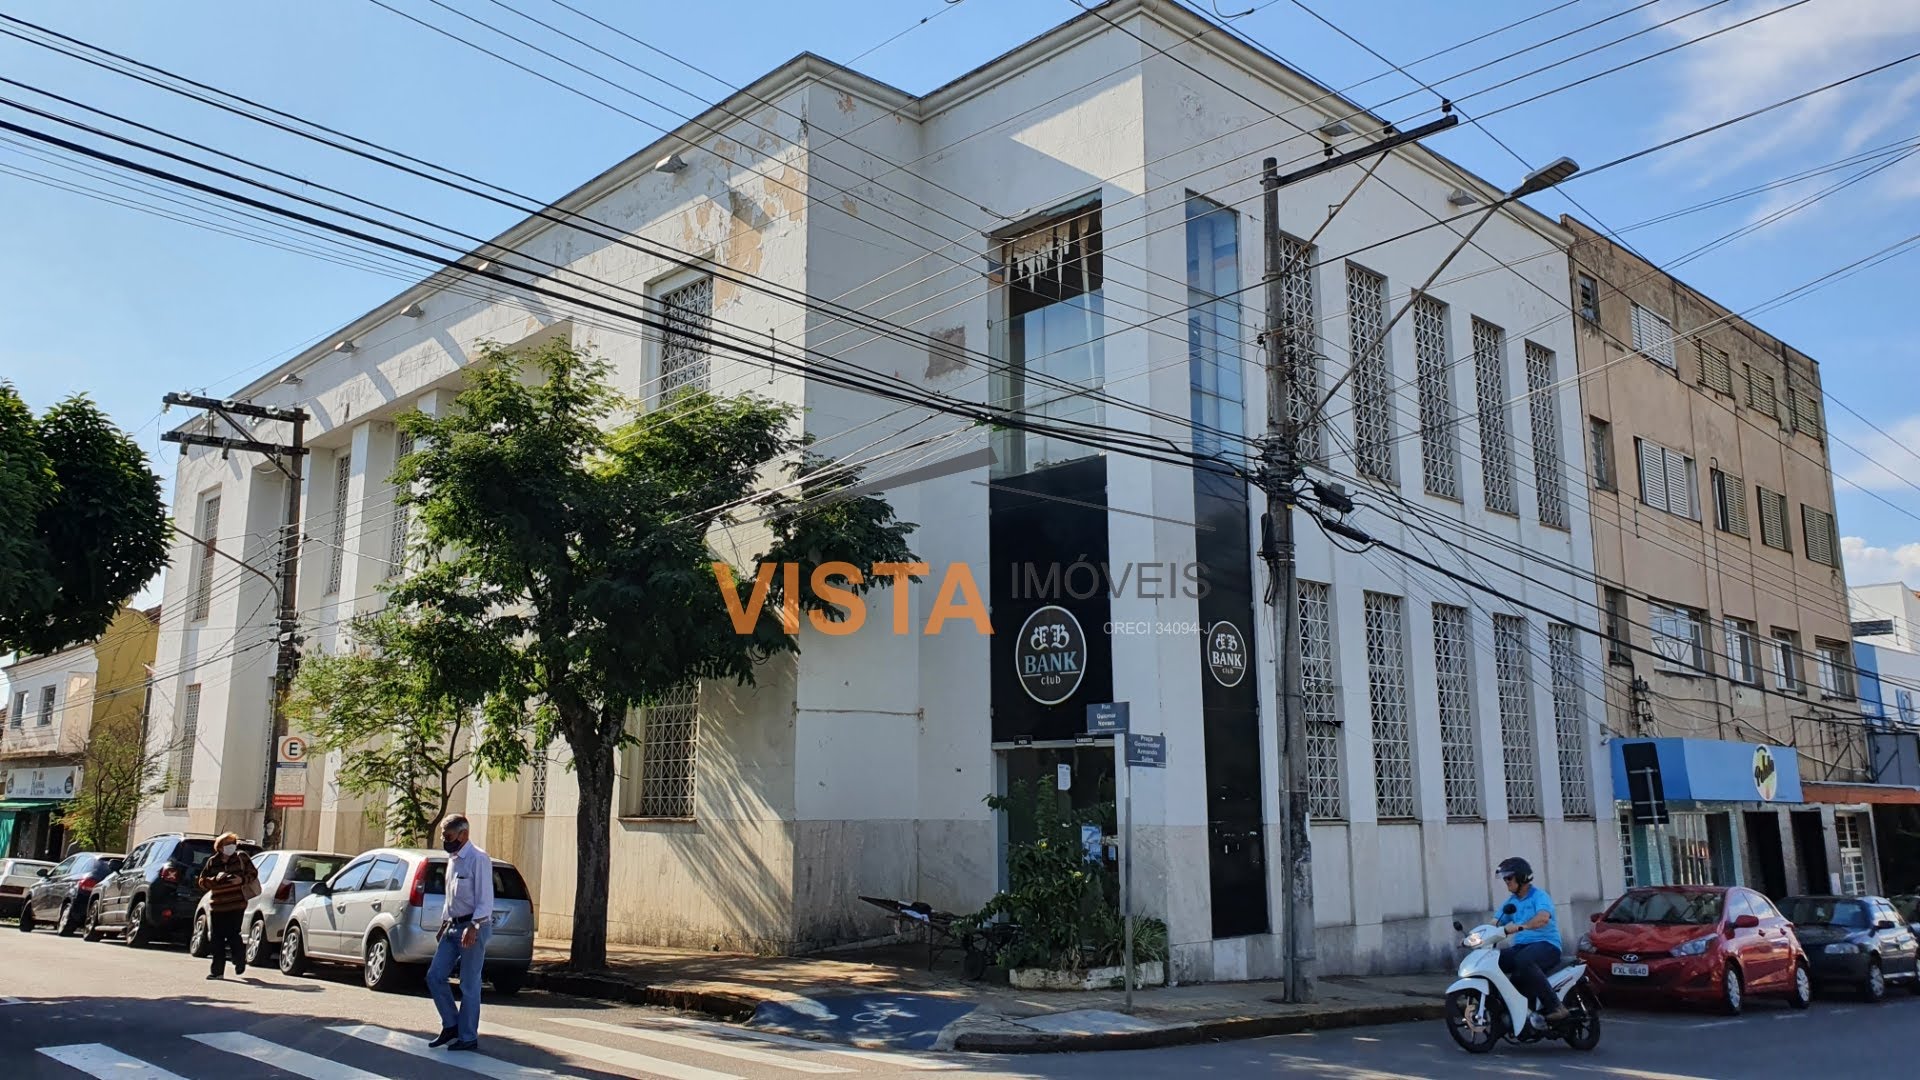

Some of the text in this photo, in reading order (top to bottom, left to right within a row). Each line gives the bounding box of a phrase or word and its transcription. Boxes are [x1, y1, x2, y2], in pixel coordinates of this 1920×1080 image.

[1024, 651, 1078, 674] BANK
[1212, 651, 1242, 667] BANK
[1040, 675, 1061, 685] club
[288, 742, 298, 755] E
[1134, 740, 1161, 748] Governador
[1137, 748, 1158, 756] Armando
